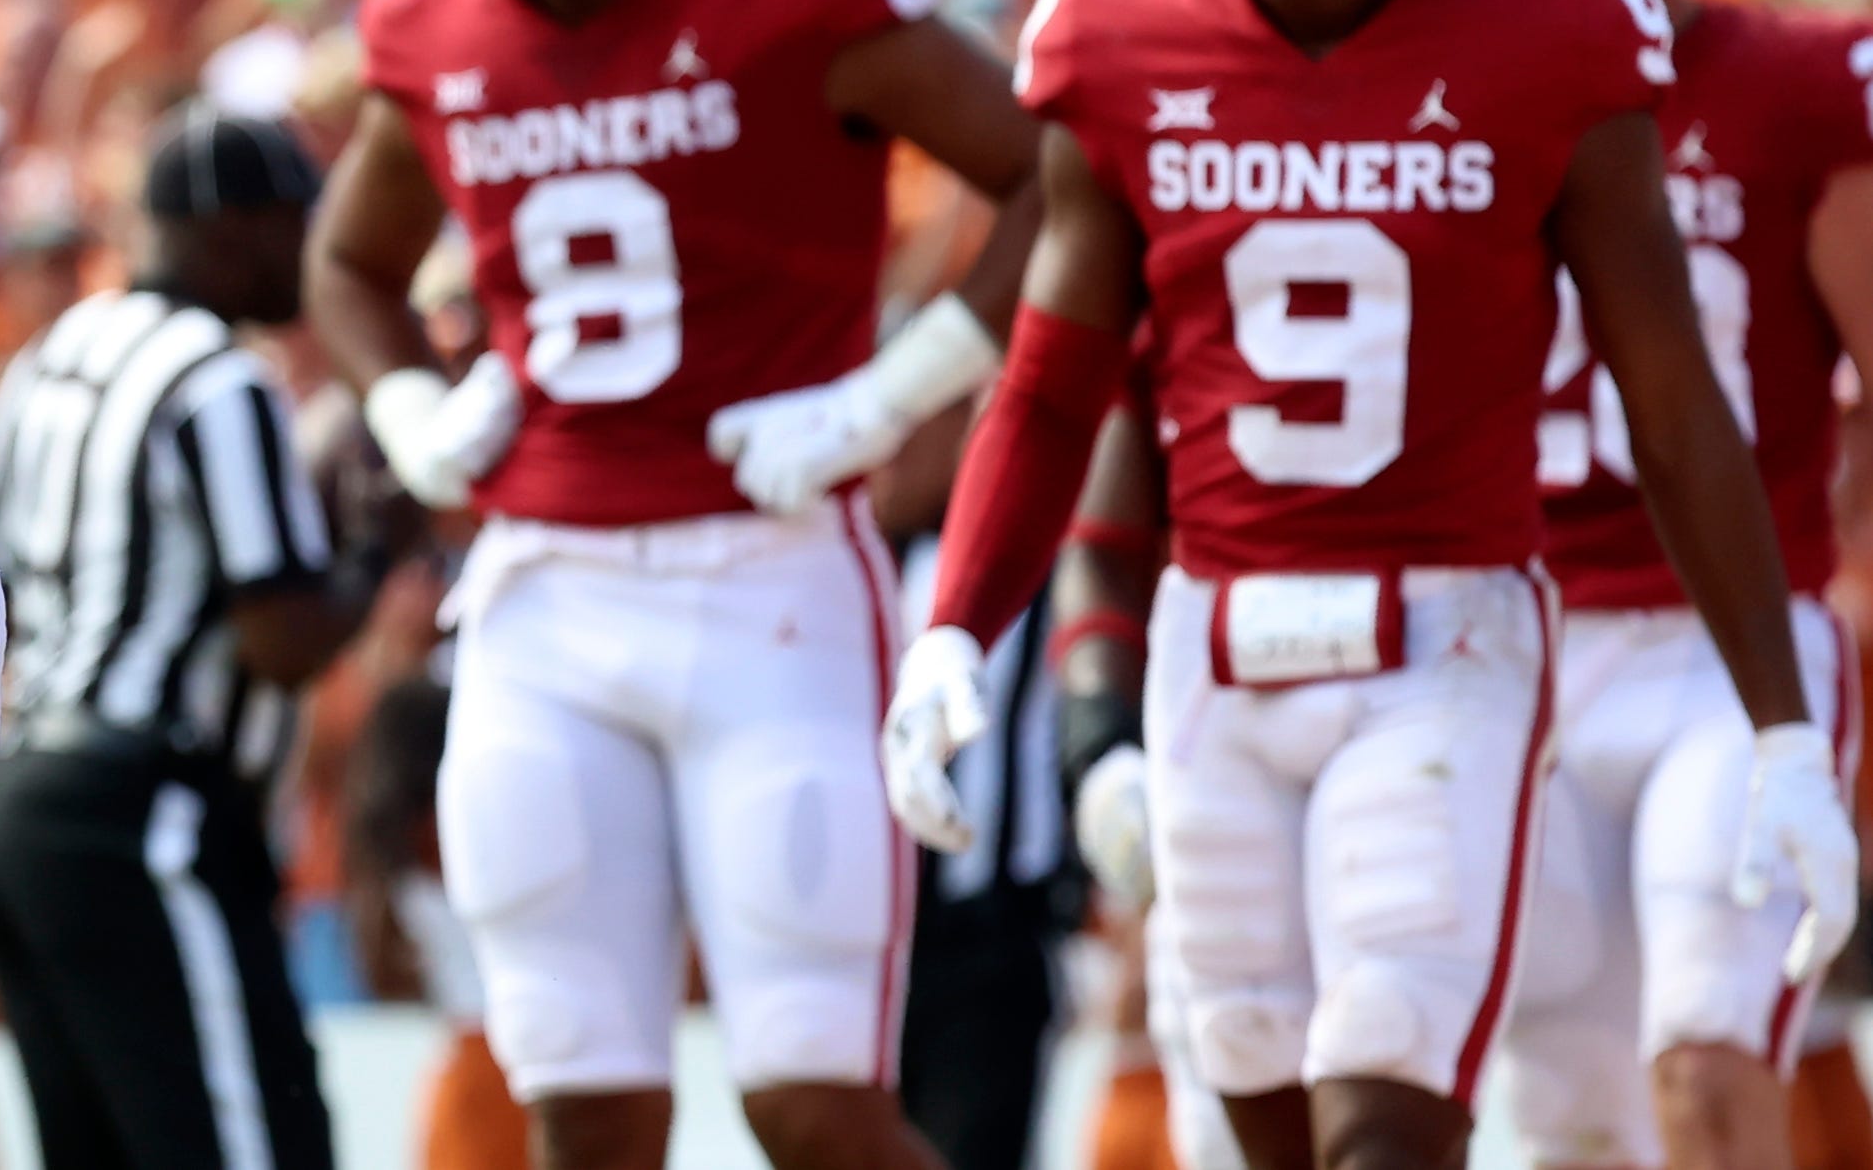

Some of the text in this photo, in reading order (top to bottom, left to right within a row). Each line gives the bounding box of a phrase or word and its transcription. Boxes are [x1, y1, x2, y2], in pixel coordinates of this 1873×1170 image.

[446, 80, 739, 186] SOONERS
[1147, 140, 1495, 212] SOONERS
[512, 169, 682, 404] 8
[1224, 219, 1411, 486] 9
